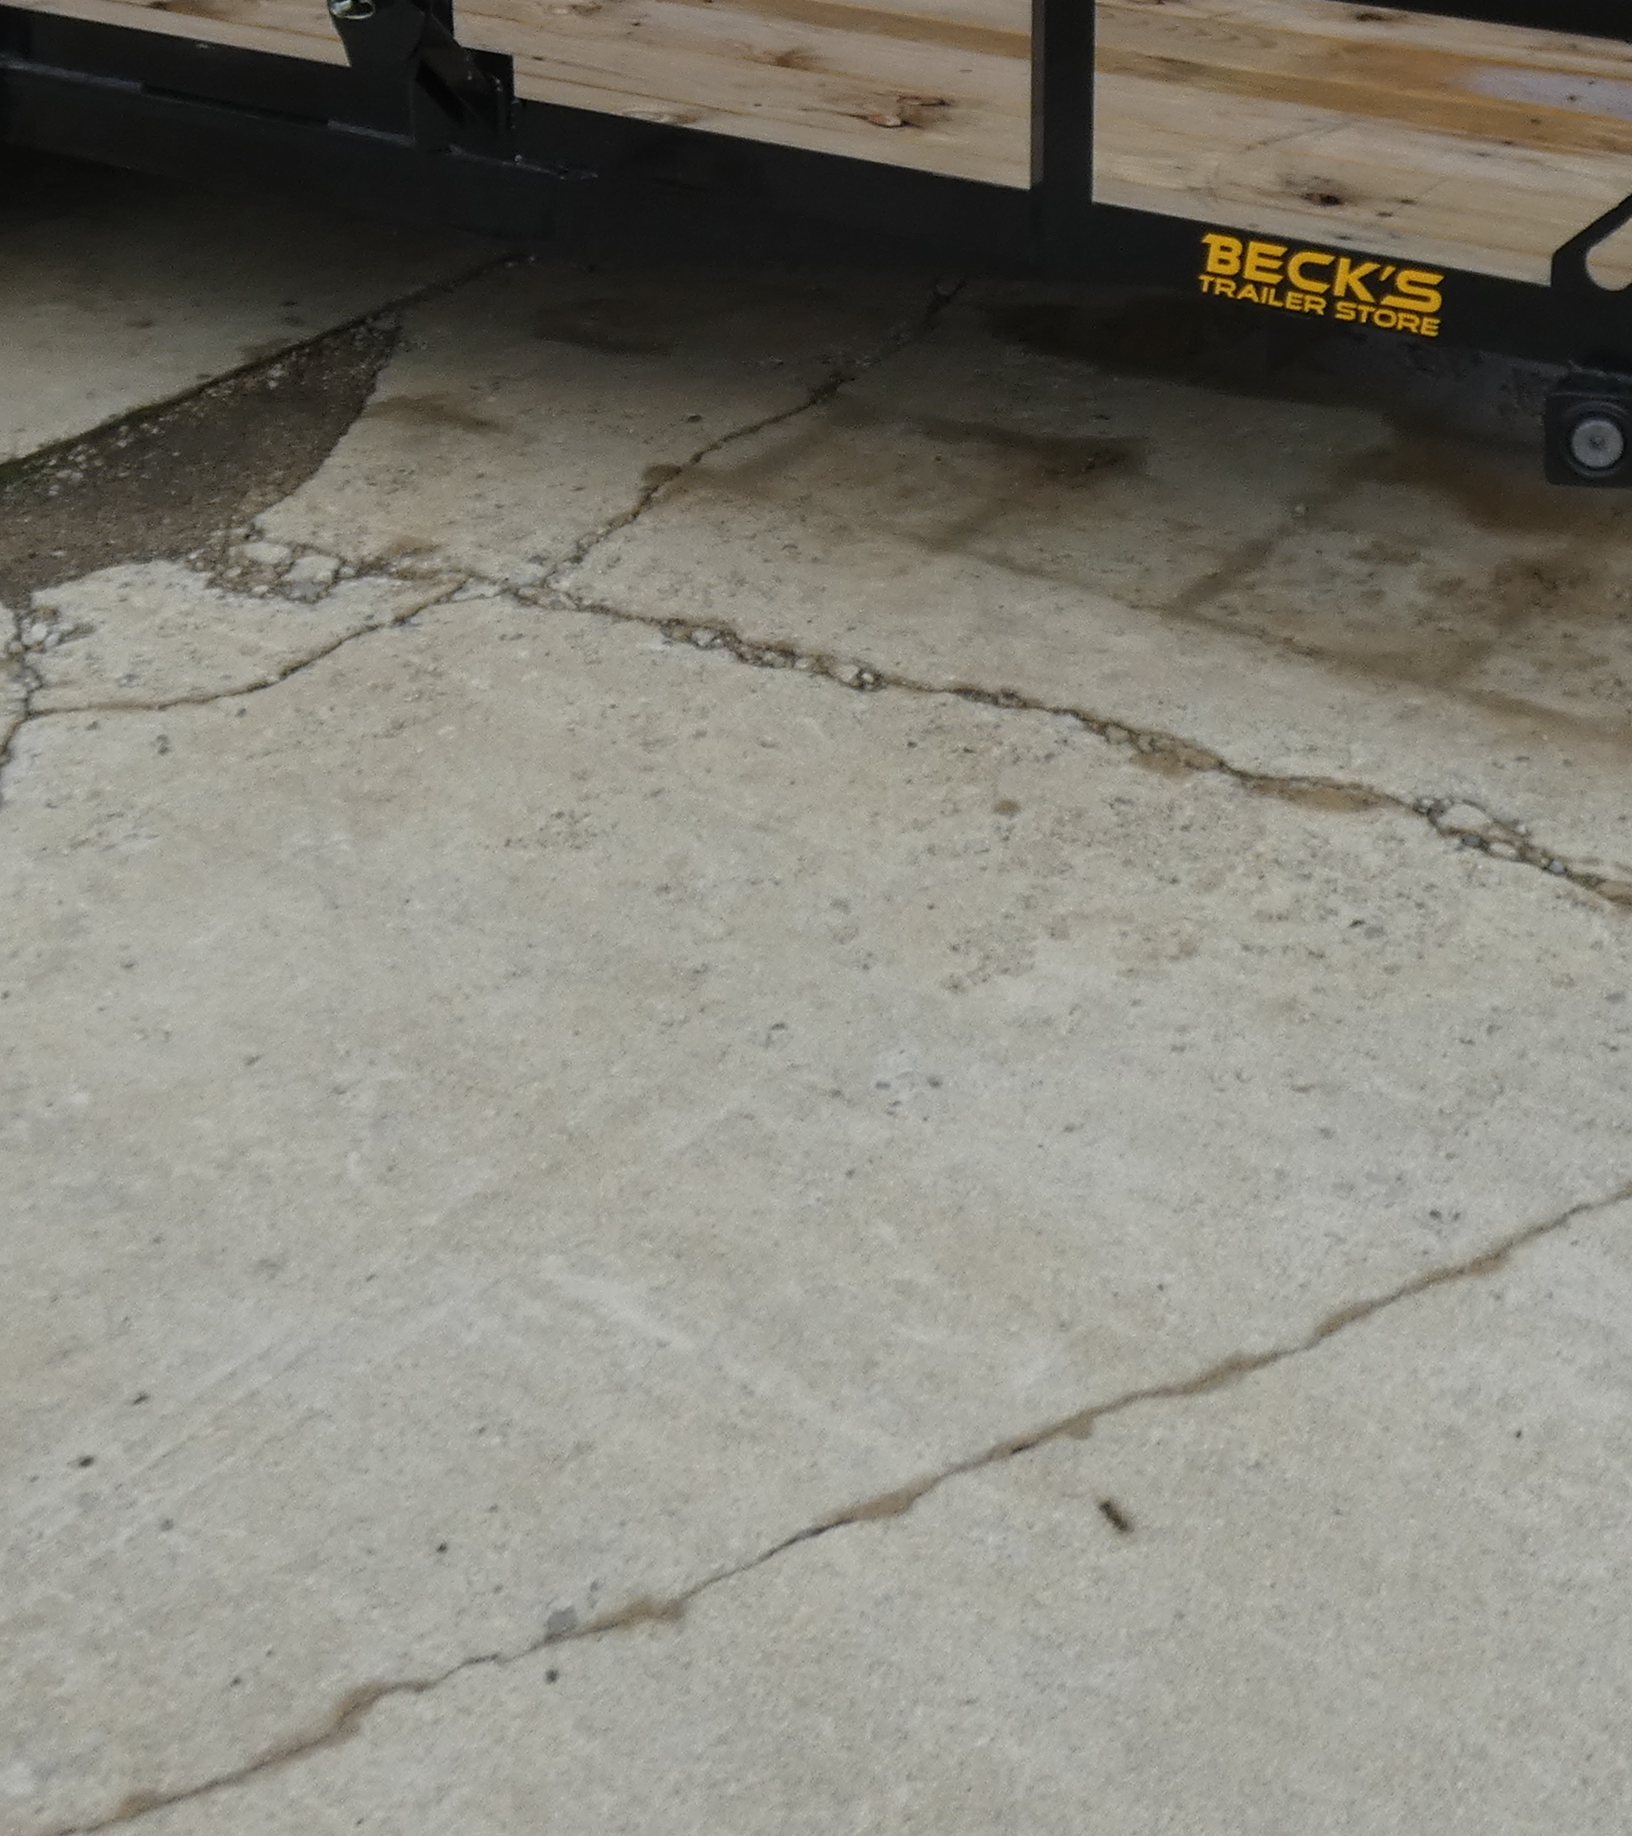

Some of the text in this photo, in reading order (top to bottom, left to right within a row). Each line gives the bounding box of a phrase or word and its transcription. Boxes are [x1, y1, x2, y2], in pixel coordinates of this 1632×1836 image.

[1197, 274, 1442, 338] TRAILER STORE
[1200, 232, 1445, 314] BECK'S
